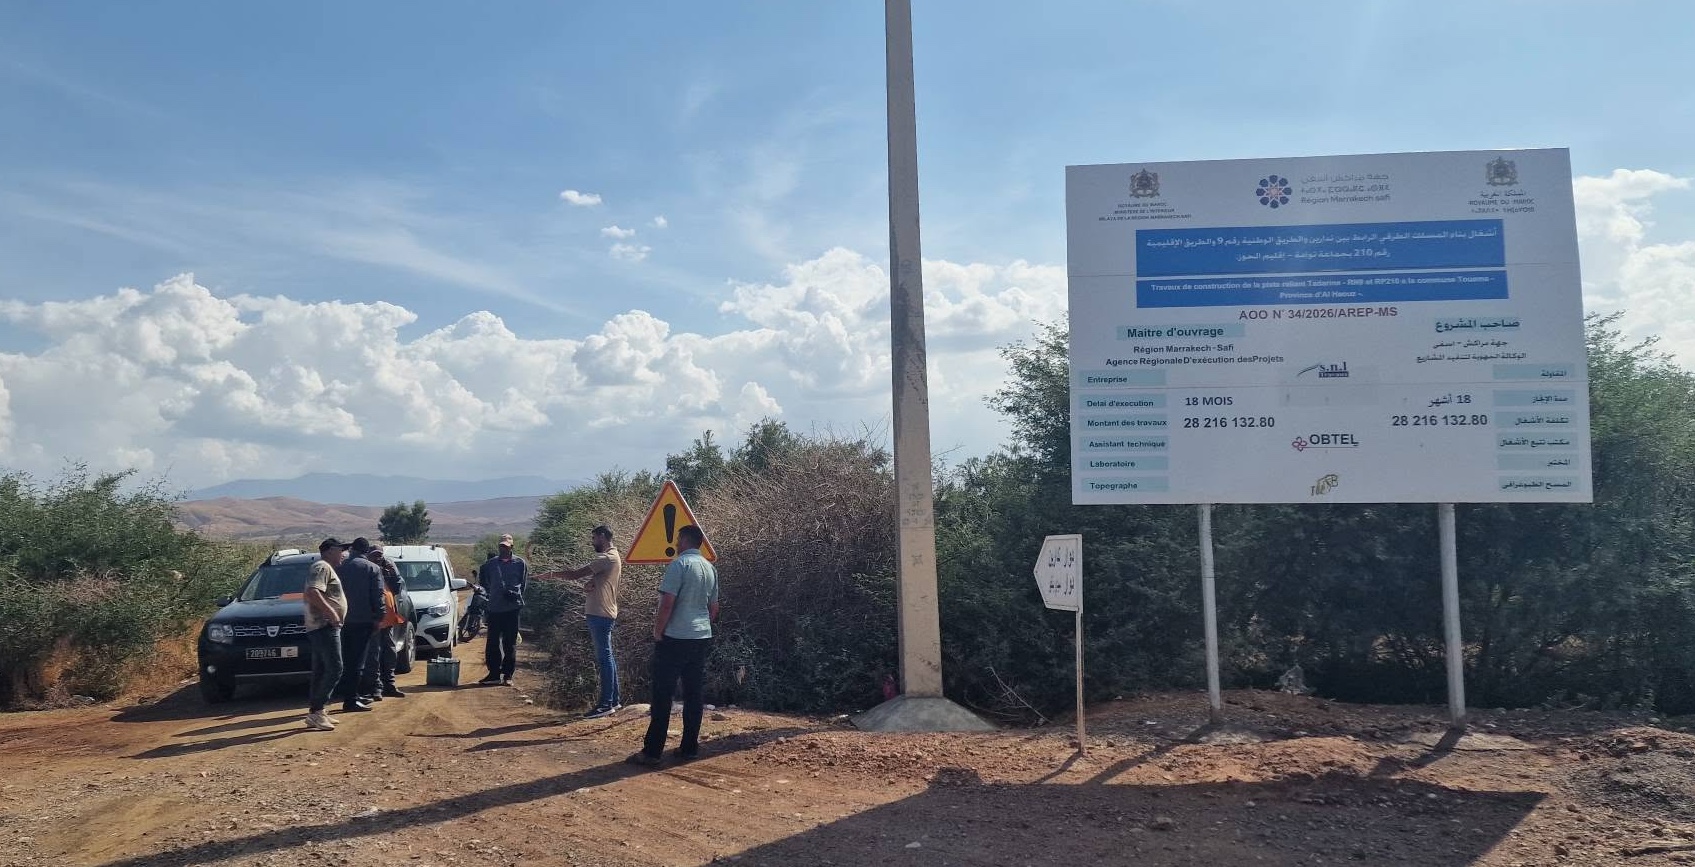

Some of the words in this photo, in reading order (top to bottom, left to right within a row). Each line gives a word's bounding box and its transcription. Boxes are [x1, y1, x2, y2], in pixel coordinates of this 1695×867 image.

[1217, 236, 1224, 246] 9
[1354, 248, 1373, 257] 210
[1239, 310, 1268, 320] AOO
[1287, 307, 1398, 320] 34/2026/AREP-MS
[1435, 317, 1477, 333] المشروع
[1480, 319, 1521, 331] صاحب
[1166, 327, 1224, 338] d'ouvrage
[1133, 345, 1164, 354] Région
[1105, 358, 1138, 367] Agence
[1087, 375, 1128, 385] Entreprise
[1185, 396, 1199, 406] 18
[1202, 396, 1233, 406] MOIS
[1427, 393, 1453, 408] أشهر
[1456, 394, 1472, 405] 18
[1087, 419, 1120, 427] Montant
[1121, 419, 1136, 427] des
[1136, 419, 1167, 427] travaux
[1184, 417, 1200, 429] 28
[1203, 417, 1228, 428] 216
[1232, 416, 1275, 428] 132.80
[1392, 415, 1409, 427] 28
[1412, 414, 1438, 426] 216
[1442, 414, 1488, 426] 132.80
[1089, 440, 1124, 448] Assistant
[1126, 440, 1166, 449] technique
[1309, 433, 1359, 446] OBTEL
[1090, 460, 1136, 469] Laboratoire
